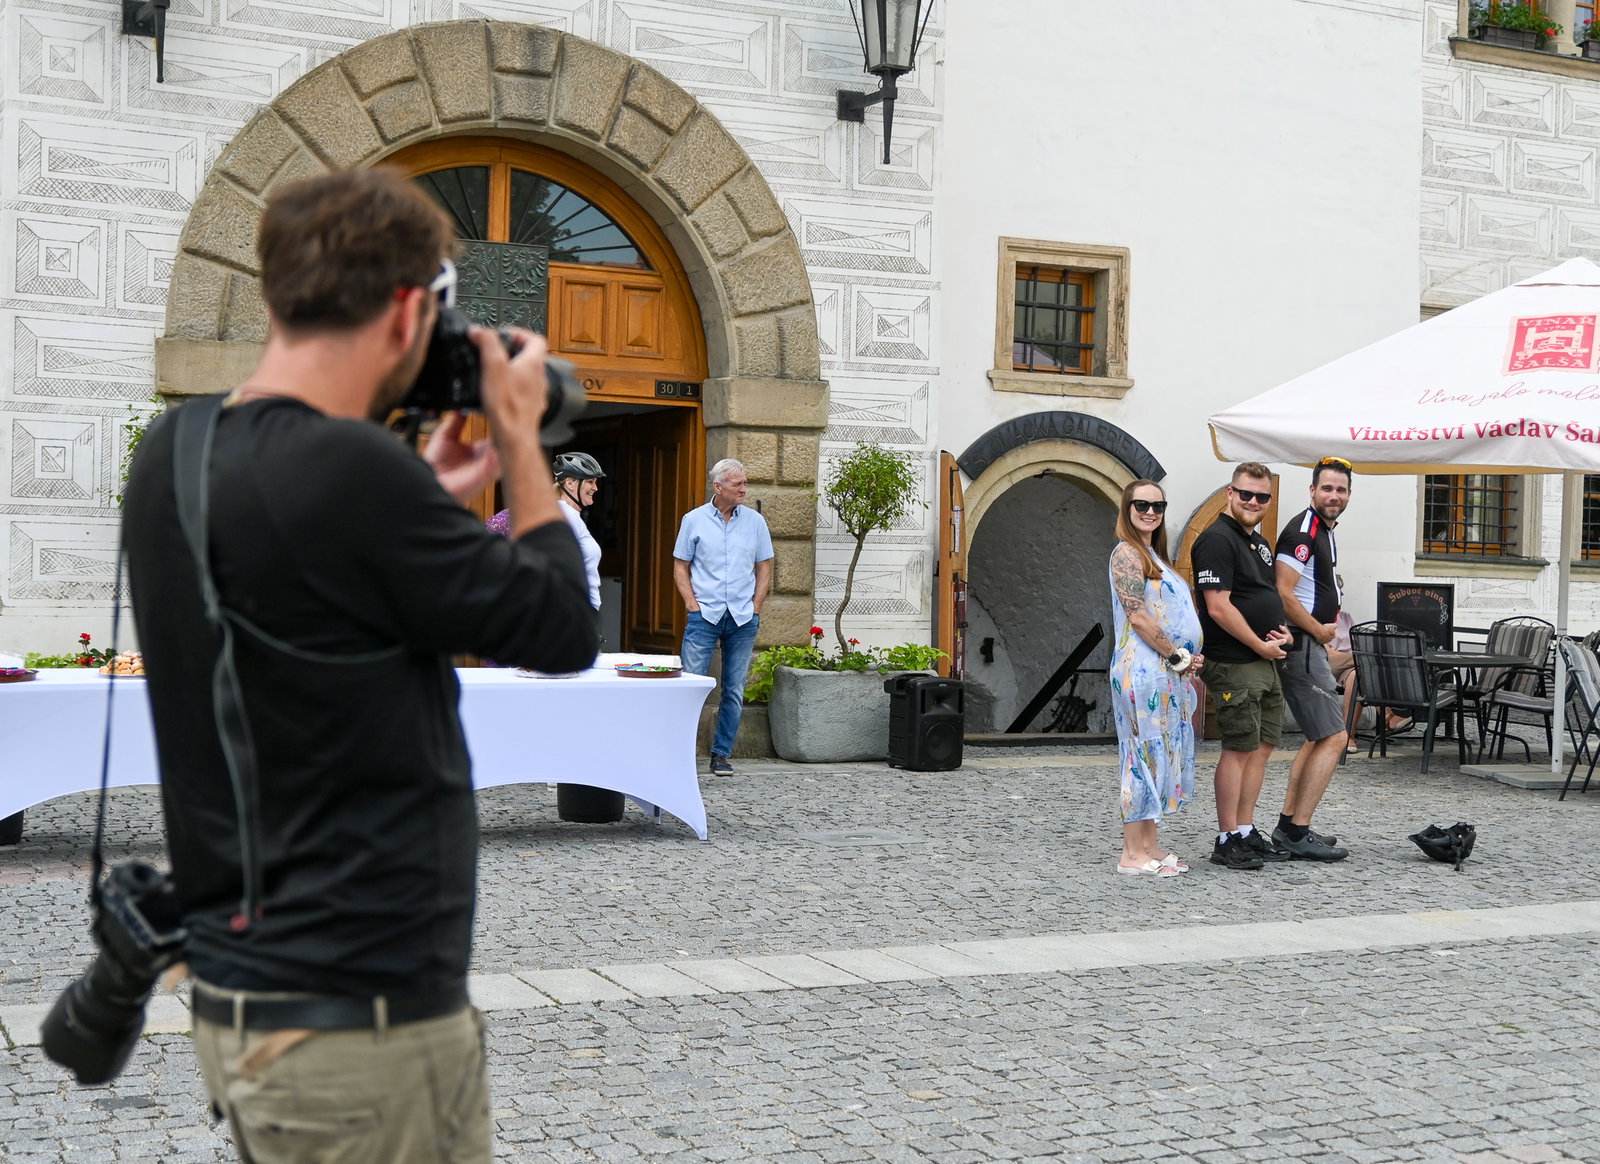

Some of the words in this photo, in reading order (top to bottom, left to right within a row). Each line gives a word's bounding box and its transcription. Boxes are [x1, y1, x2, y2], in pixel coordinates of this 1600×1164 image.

[1519, 315, 1594, 327] VINAŘ
[1511, 356, 1586, 370] ŠALŠA
[660, 383, 674, 394] 30
[685, 385, 693, 396] 1
[1468, 381, 1532, 407] jako
[1062, 415, 1133, 455] GALERIE
[1347, 424, 1465, 441] Vinařství
[1473, 417, 1558, 439] Václav
